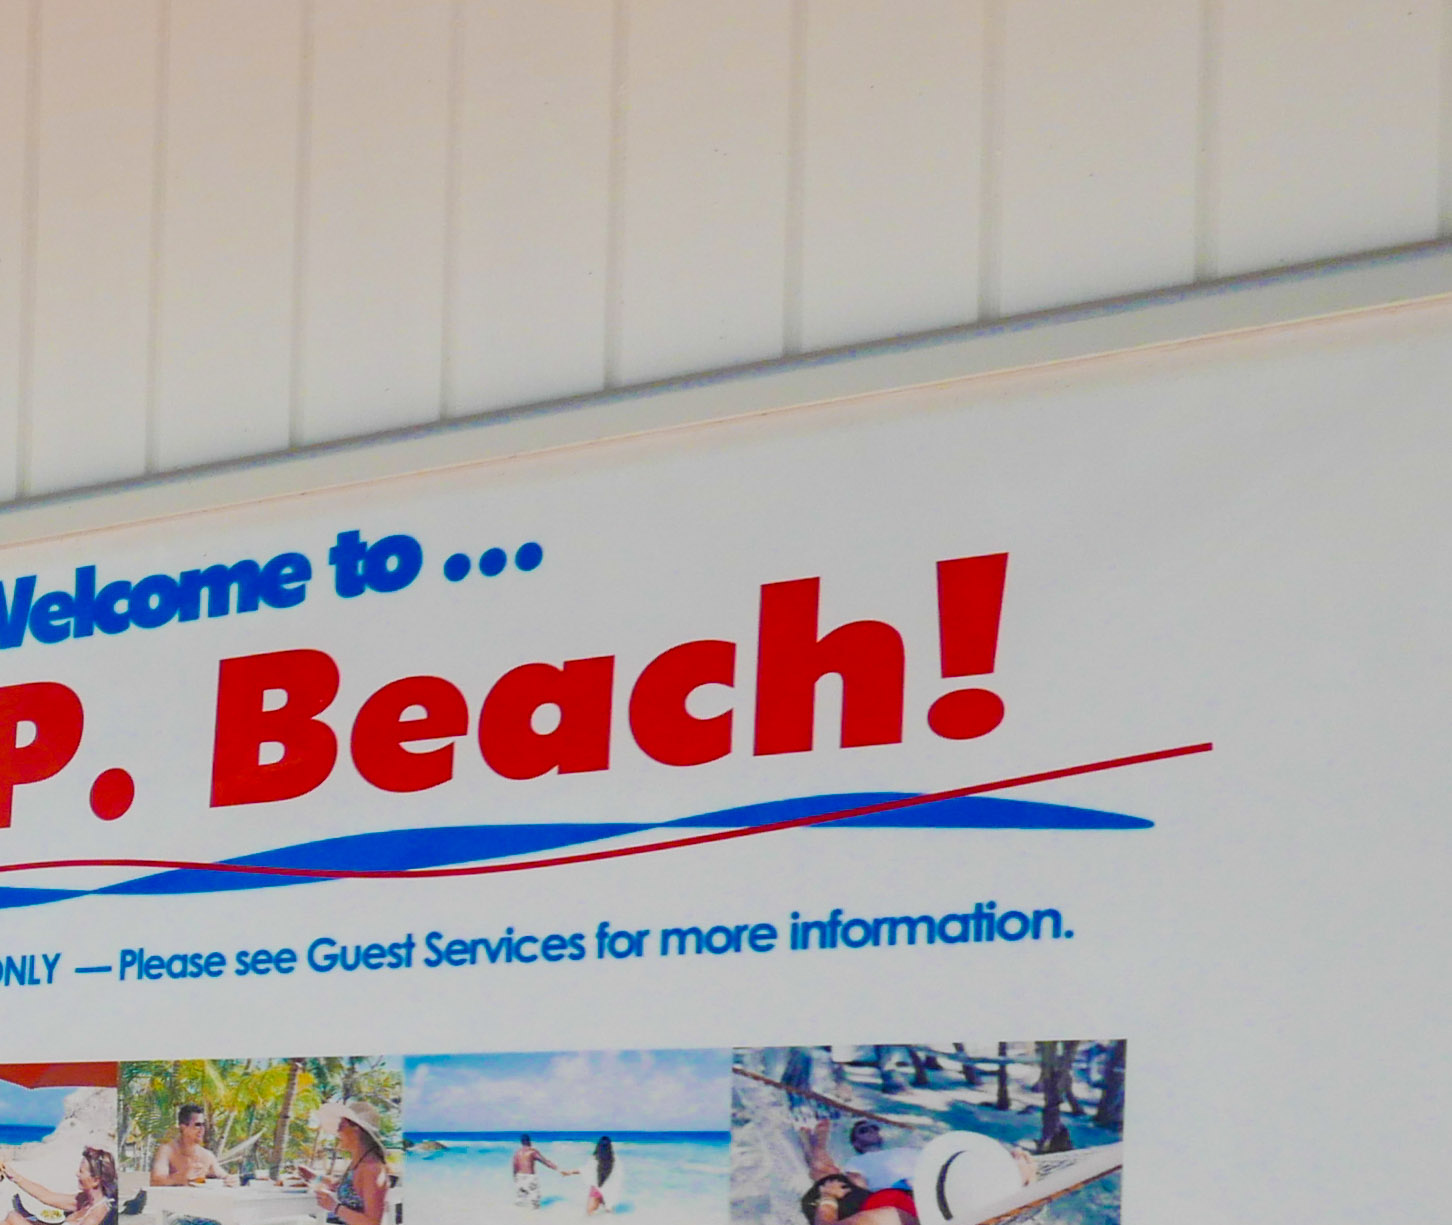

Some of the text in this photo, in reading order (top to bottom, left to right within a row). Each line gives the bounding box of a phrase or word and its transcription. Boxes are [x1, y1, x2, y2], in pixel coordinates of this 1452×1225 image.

[327, 528, 424, 600] to
[209, 552, 1008, 808] Beach!
[118, 947, 228, 982] Please
[234, 947, 299, 977] see
[306, 933, 416, 974] Guest
[423, 926, 586, 968] Services
[595, 920, 651, 960] for
[659, 922, 779, 957] more
[789, 900, 1074, 952] information.
